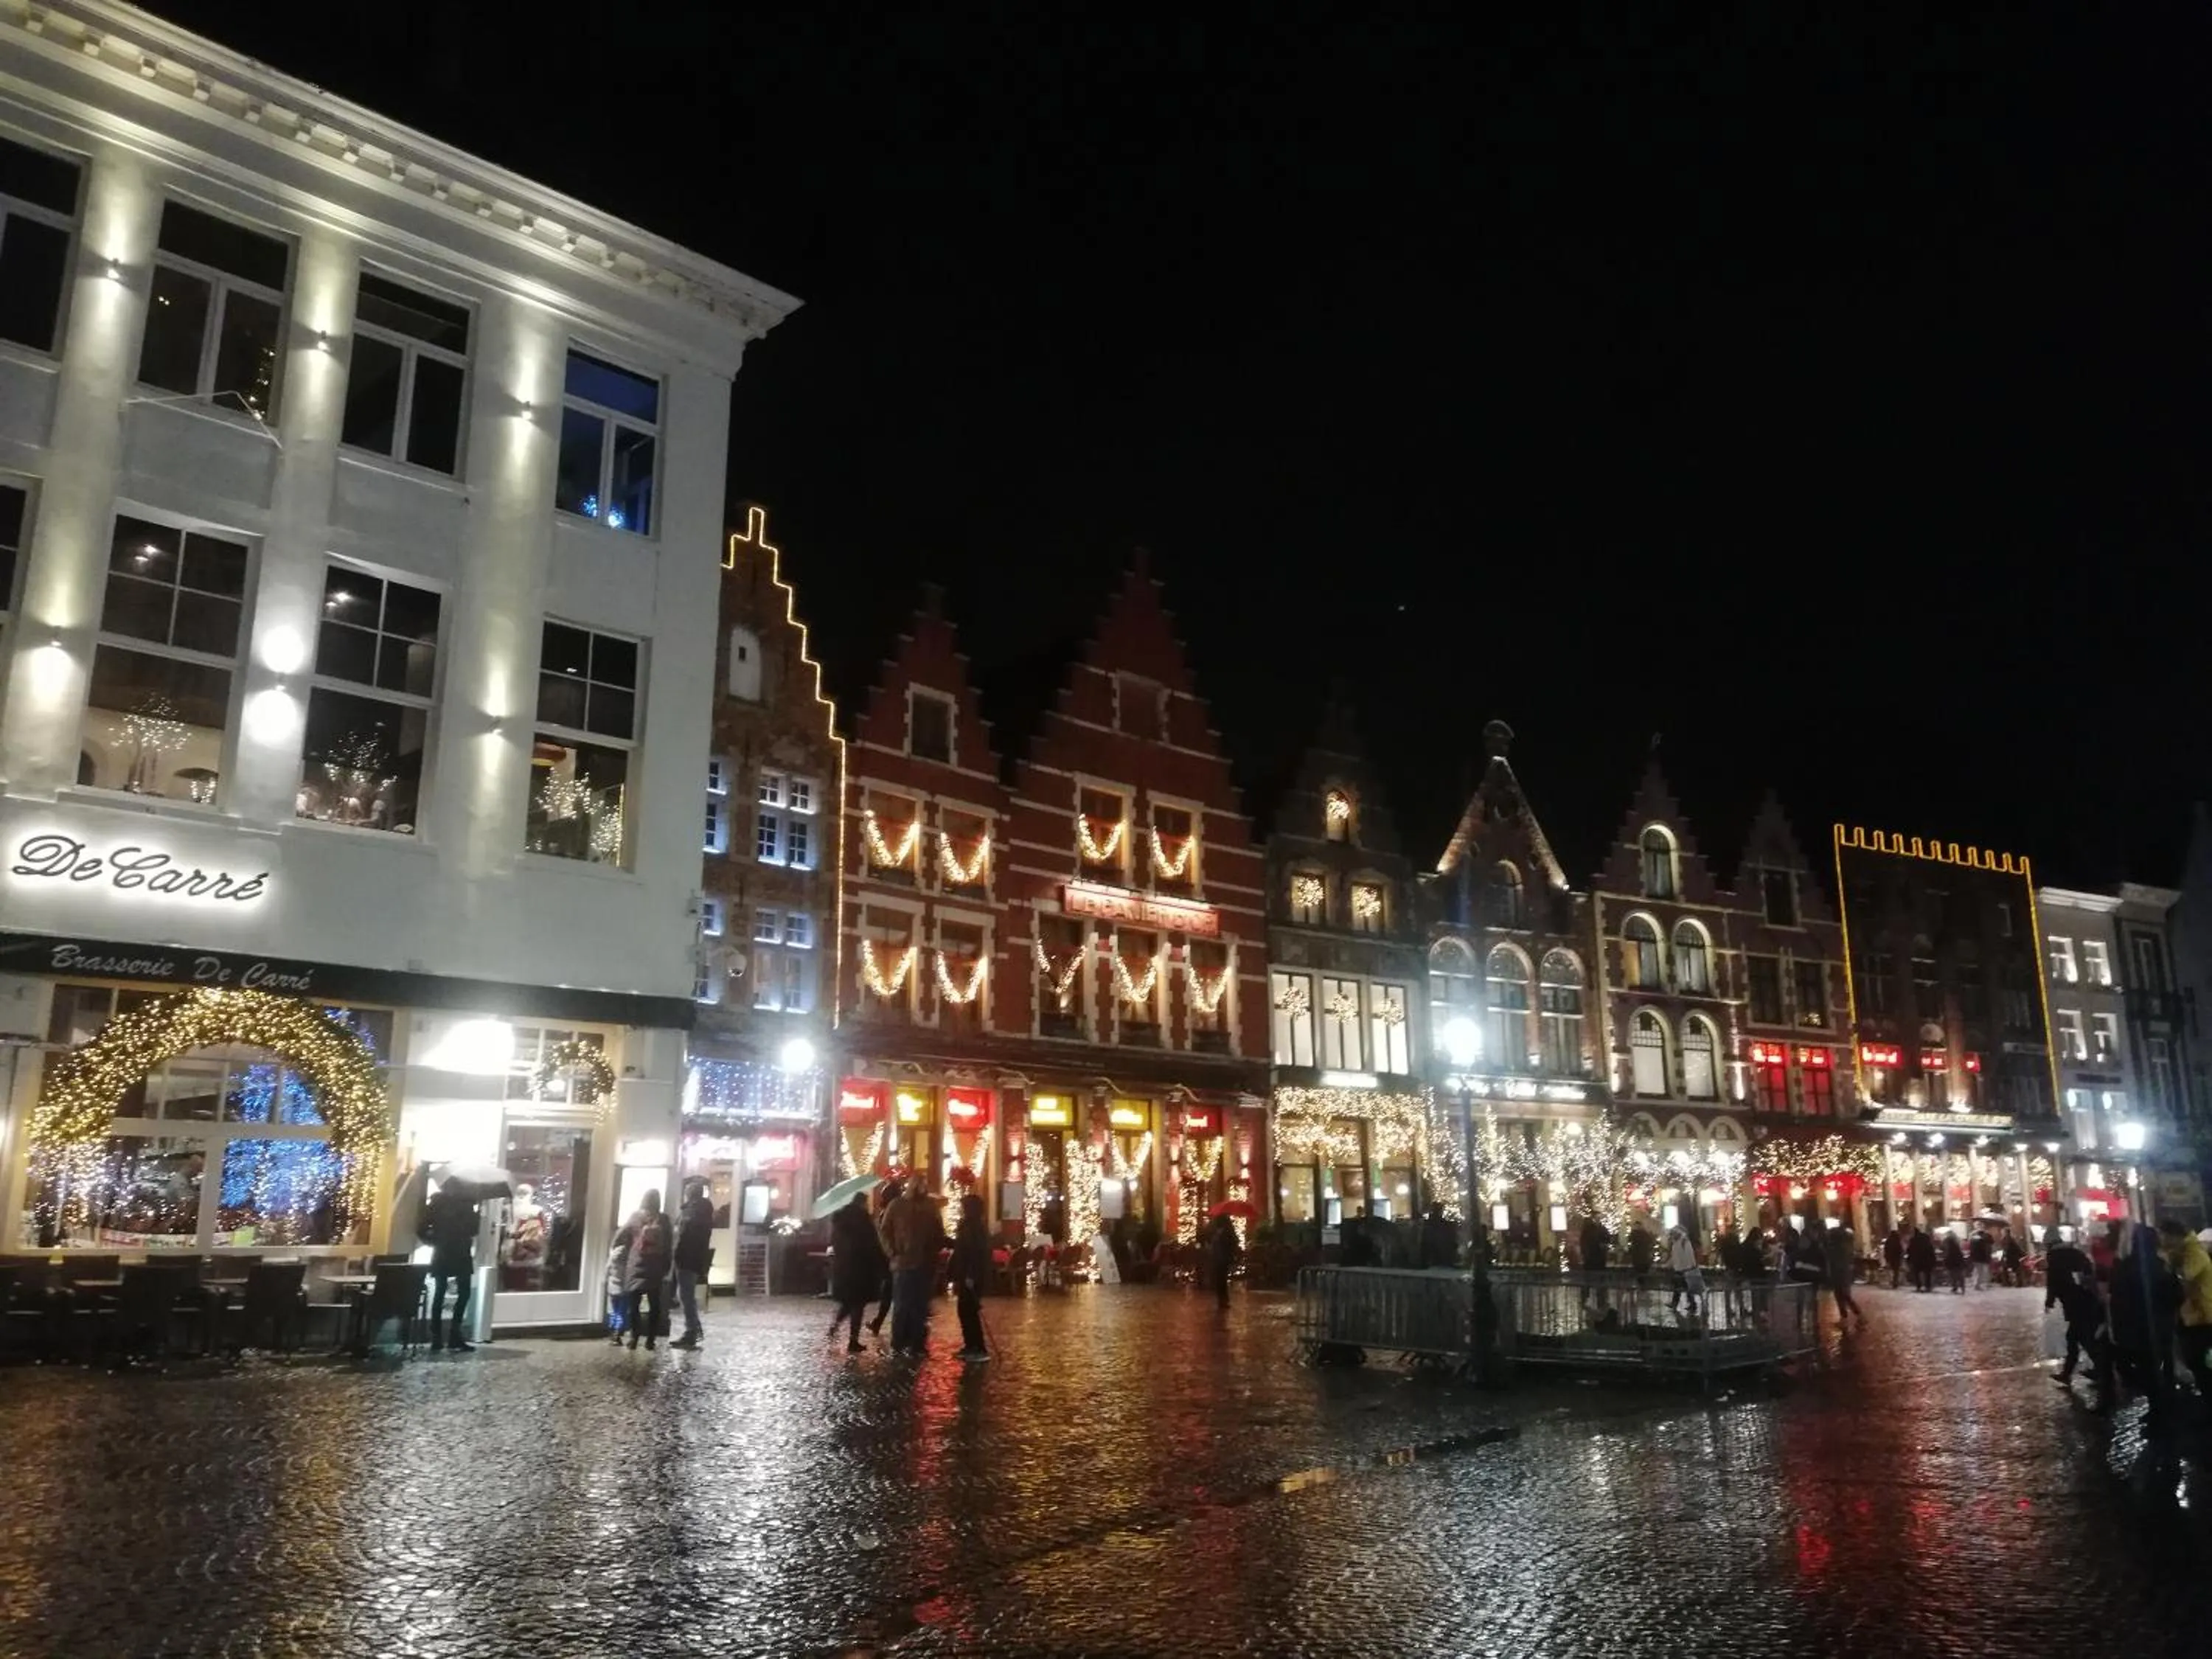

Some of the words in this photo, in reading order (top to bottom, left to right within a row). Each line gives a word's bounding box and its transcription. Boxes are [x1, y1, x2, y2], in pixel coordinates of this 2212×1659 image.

[12, 835, 102, 881] De
[109, 847, 268, 901] Carré
[51, 944, 175, 976] Brasserie
[193, 956, 231, 982] De
[240, 963, 313, 990] Carré
